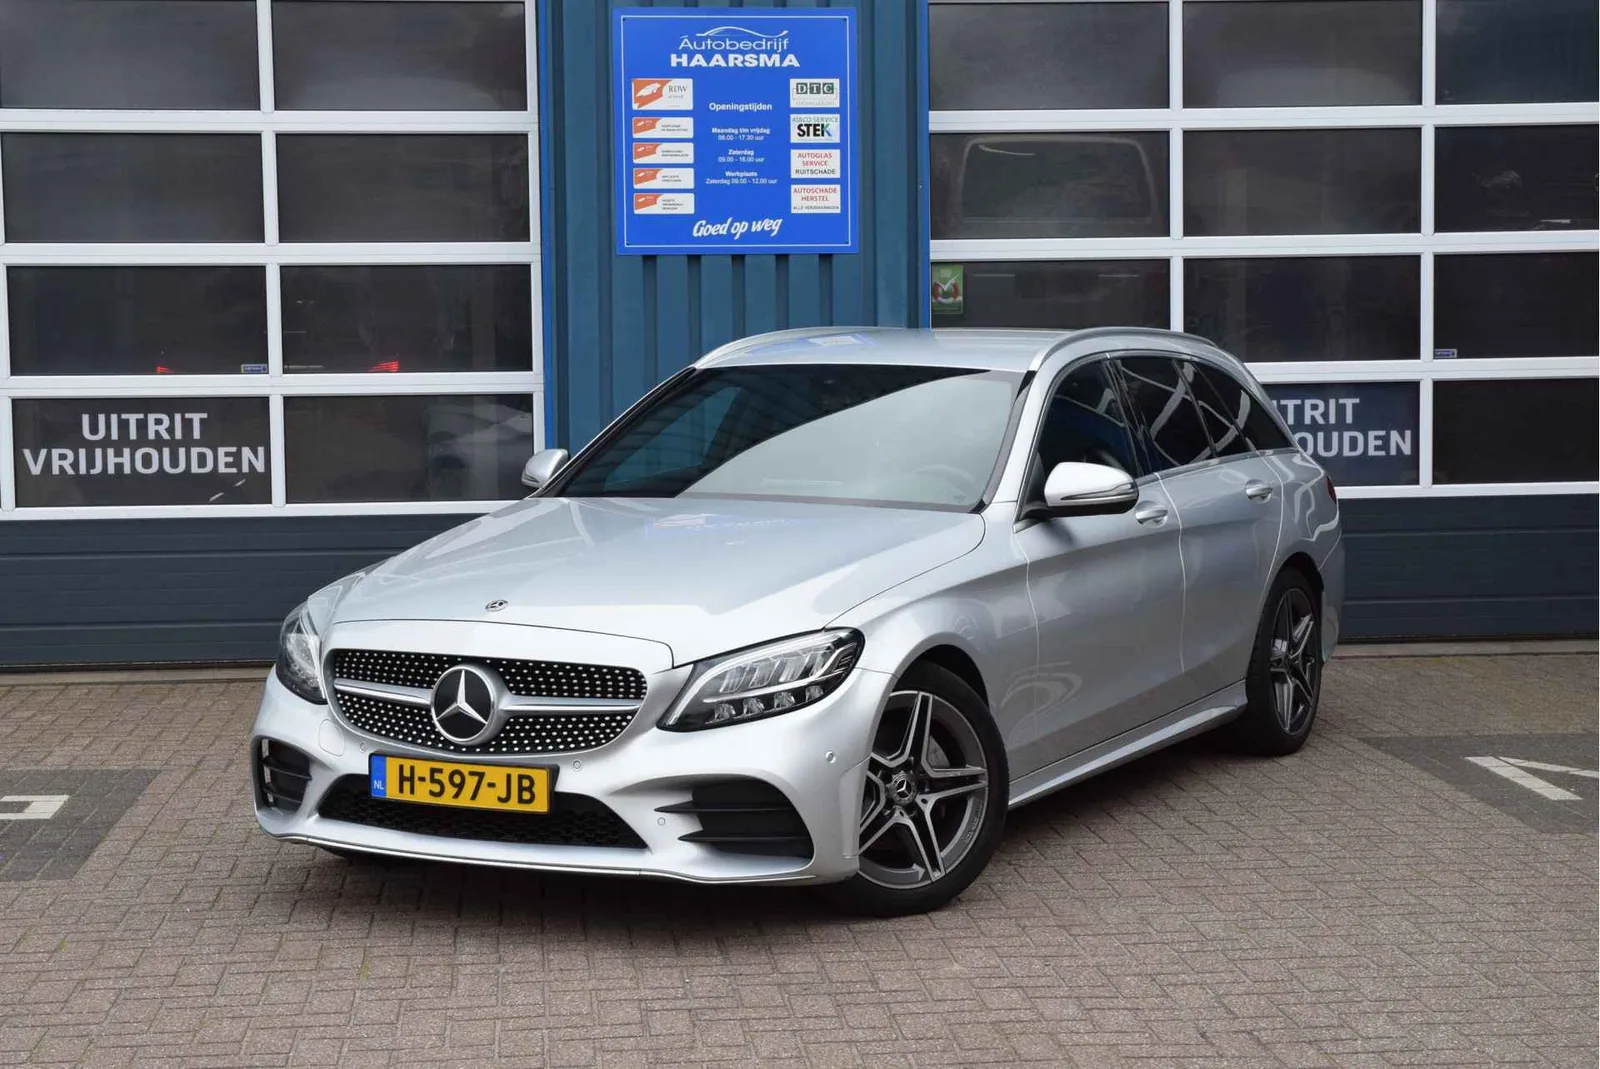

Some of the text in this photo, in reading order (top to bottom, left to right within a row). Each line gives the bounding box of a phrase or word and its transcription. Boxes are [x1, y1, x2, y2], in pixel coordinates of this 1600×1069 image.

[679, 37, 789, 52] Autobedrijf
[670, 53, 800, 68] HAARSMA
[668, 84, 688, 93] RDW
[797, 83, 834, 95] DTC
[709, 102, 773, 112] Openingstijden
[797, 123, 833, 137] STEK
[692, 217, 783, 240] Goed op weg
[1271, 398, 1360, 425] TRIT
[81, 412, 208, 441] UITRIT
[22, 446, 265, 475] VRIJHOUDEN
[373, 779, 385, 790] NL
[398, 764, 536, 805] H-597-JB
